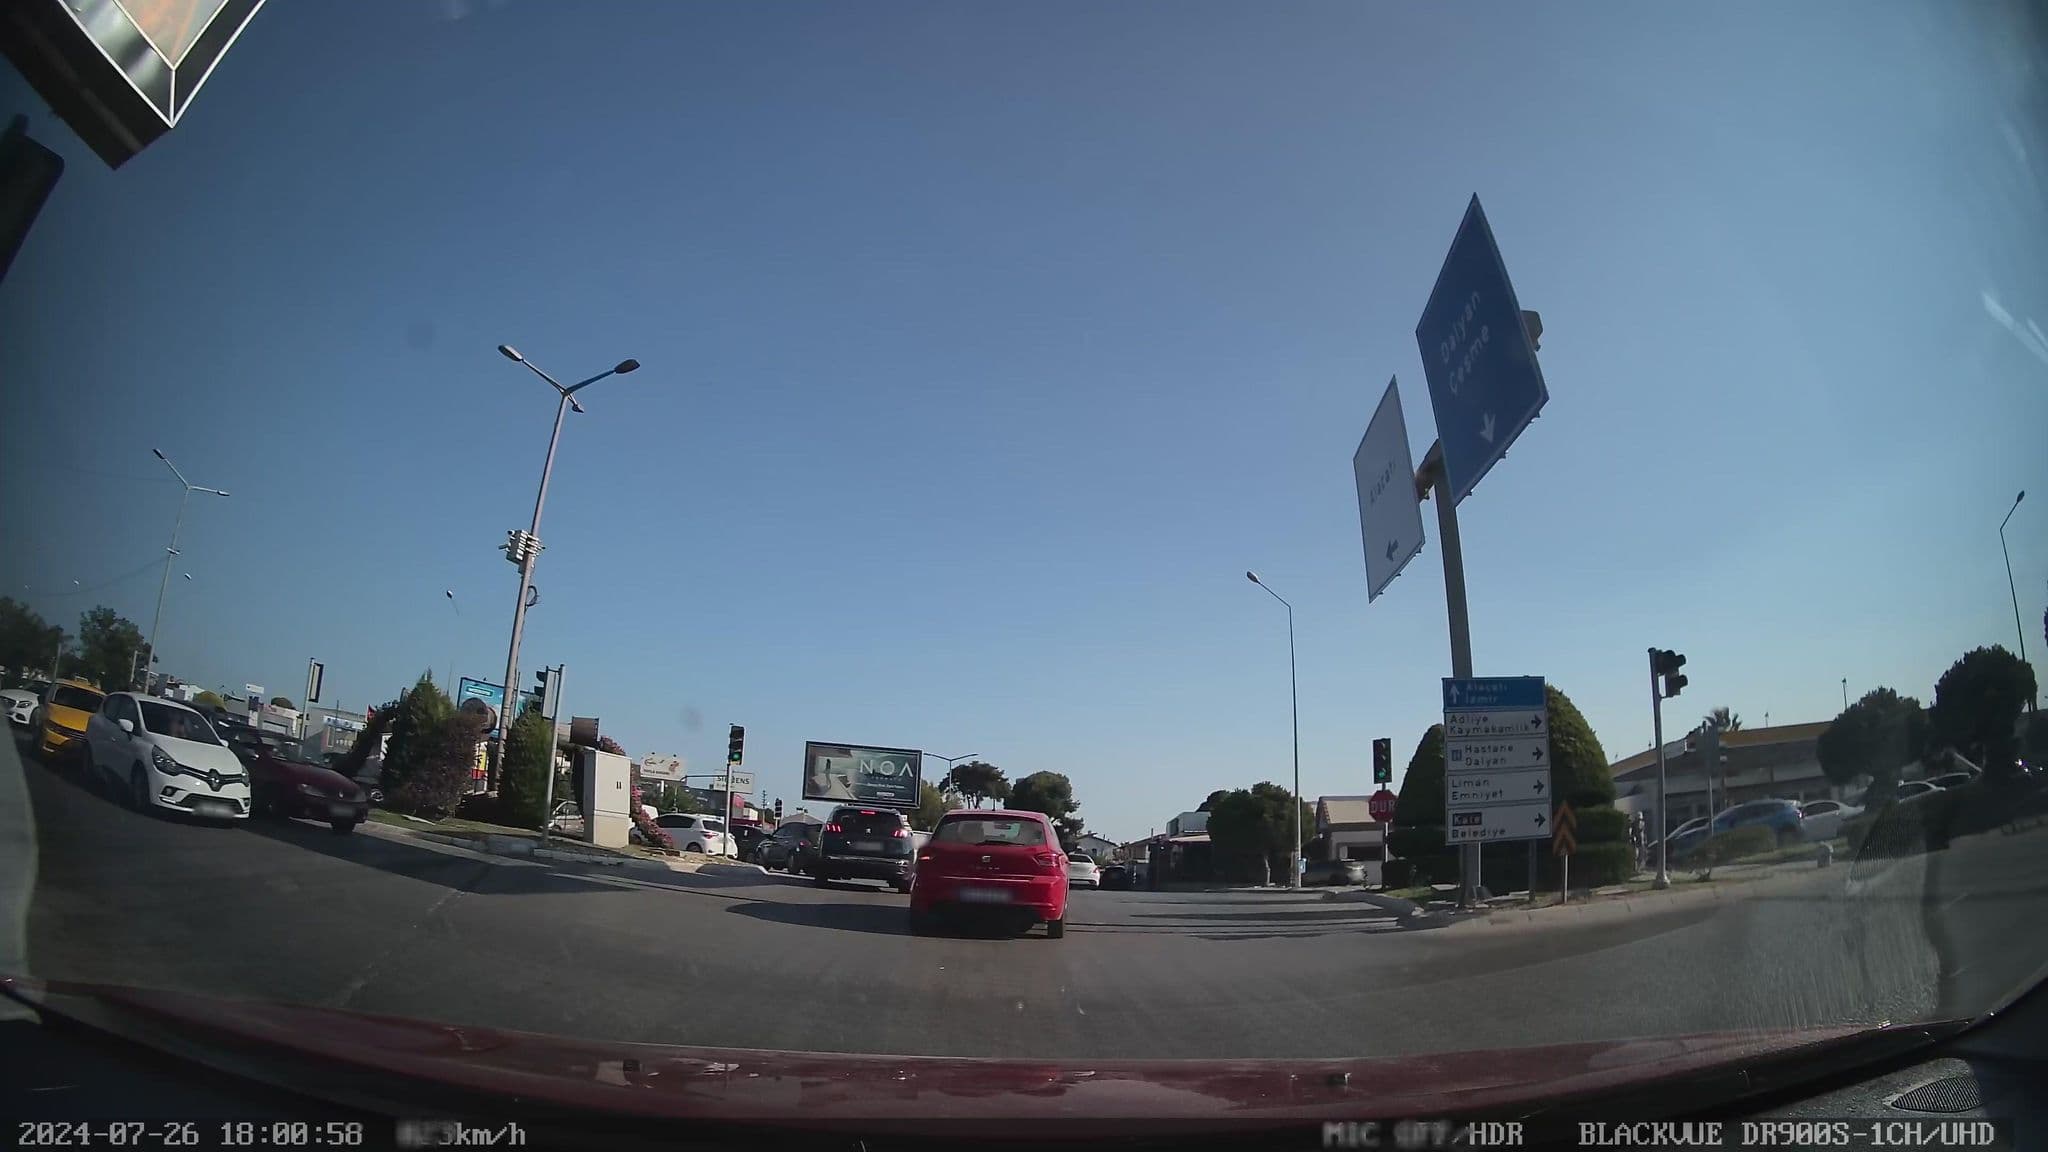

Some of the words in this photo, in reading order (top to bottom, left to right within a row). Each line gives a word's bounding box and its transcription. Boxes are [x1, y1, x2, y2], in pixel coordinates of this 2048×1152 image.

[1440, 290, 1481, 365] Dalyan
[1450, 714, 1488, 726] Adliye
[1464, 744, 1514, 754] Hastane
[1465, 757, 1506, 767] Dalyan
[1452, 779, 1490, 788] Liman
[1452, 788, 1503, 800] Emniyet
[1370, 799, 1396, 814] DUR
[1452, 828, 1506, 839] Belediye
